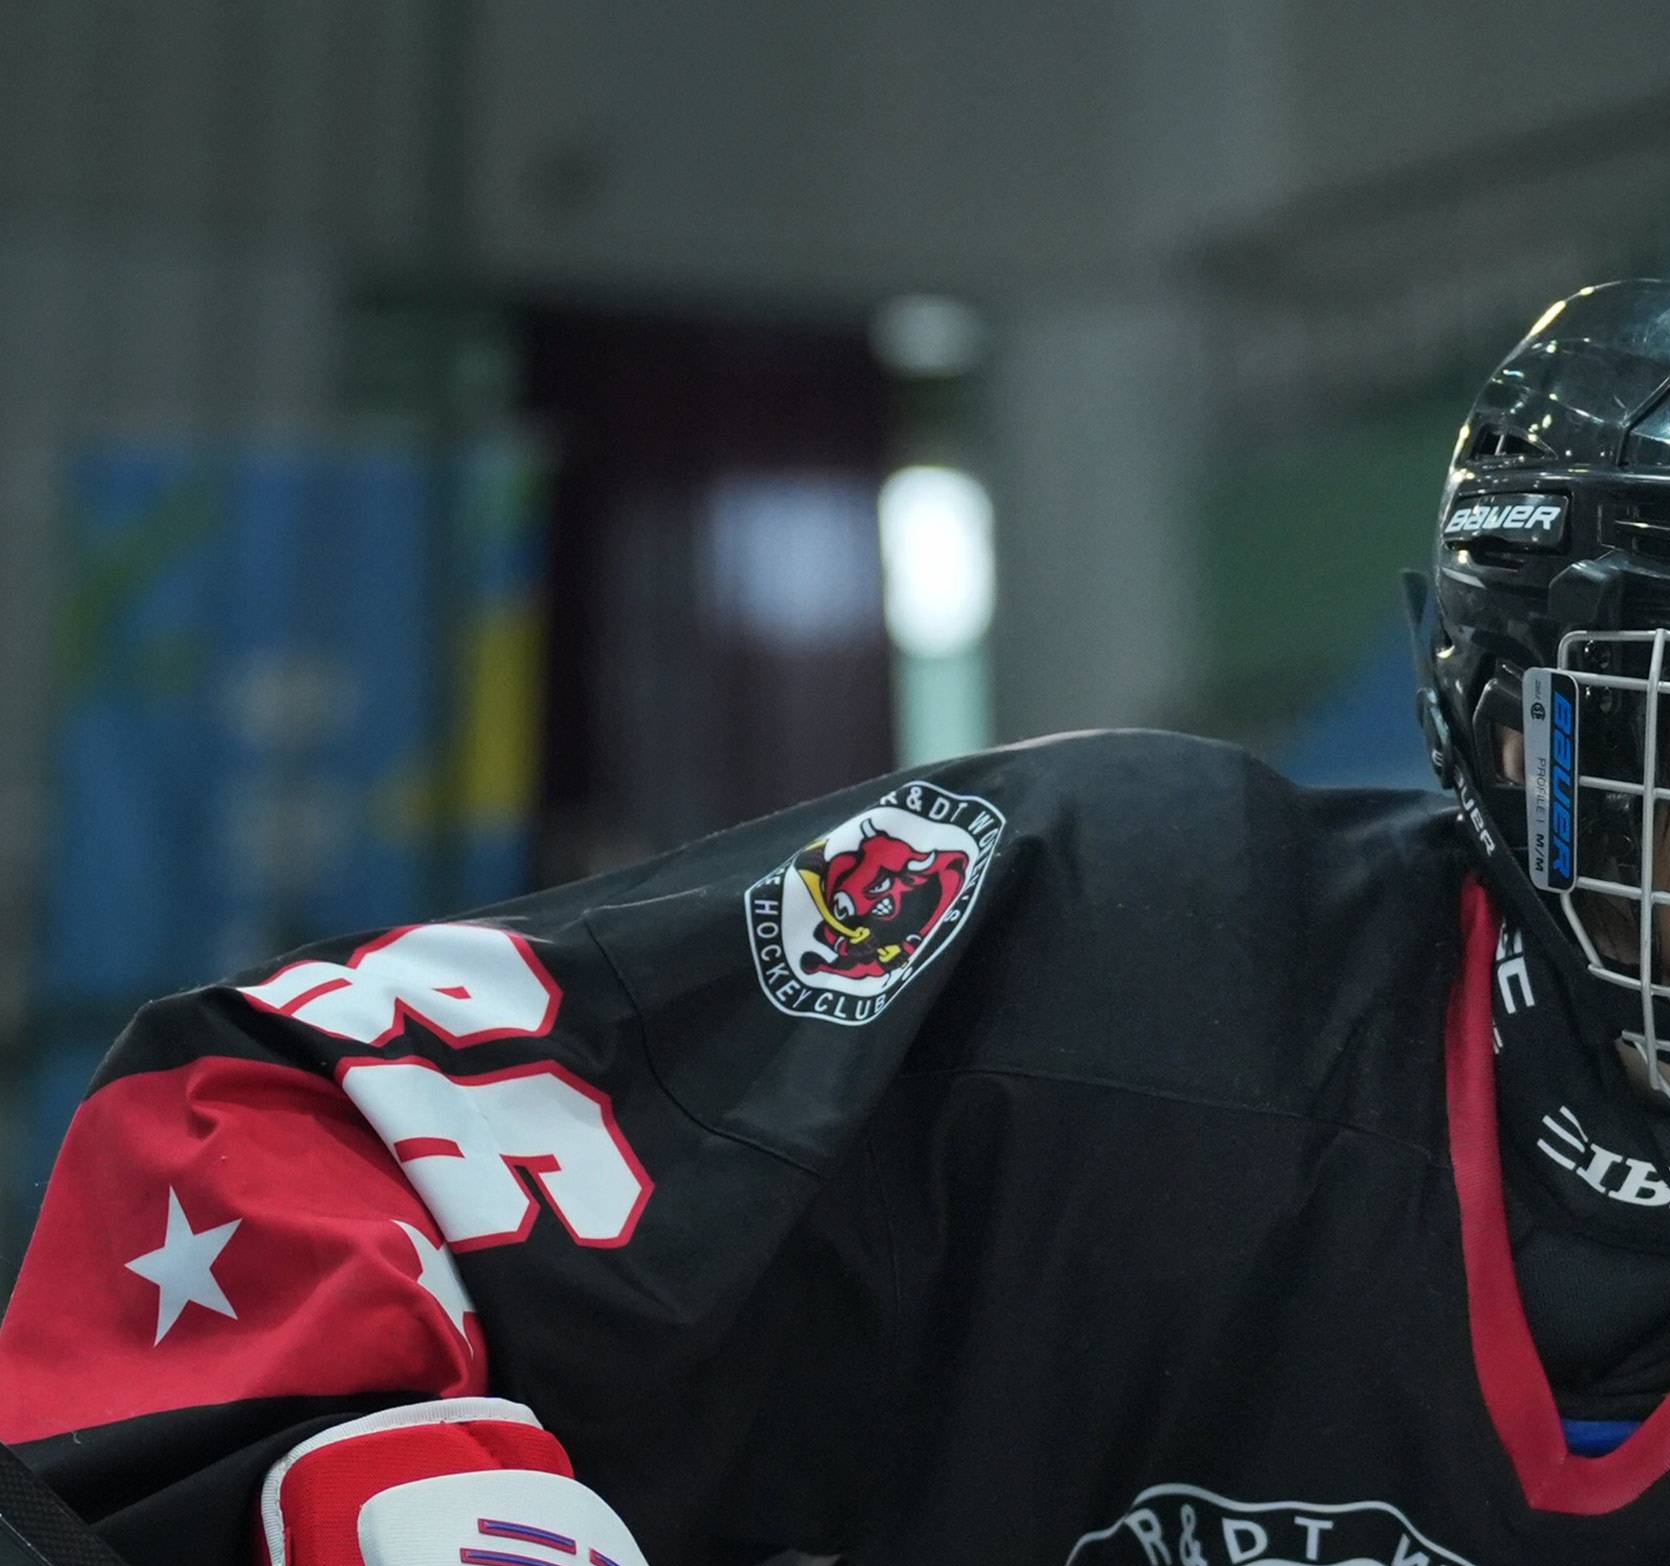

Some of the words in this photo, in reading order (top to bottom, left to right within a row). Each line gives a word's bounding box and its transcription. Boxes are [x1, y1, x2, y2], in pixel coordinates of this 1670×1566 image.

[1445, 505, 1561, 534] BAUER
[1552, 691, 1573, 880] BAUER
[754, 899, 812, 1009] HOCKEY
[813, 992, 887, 1020] CLUB
